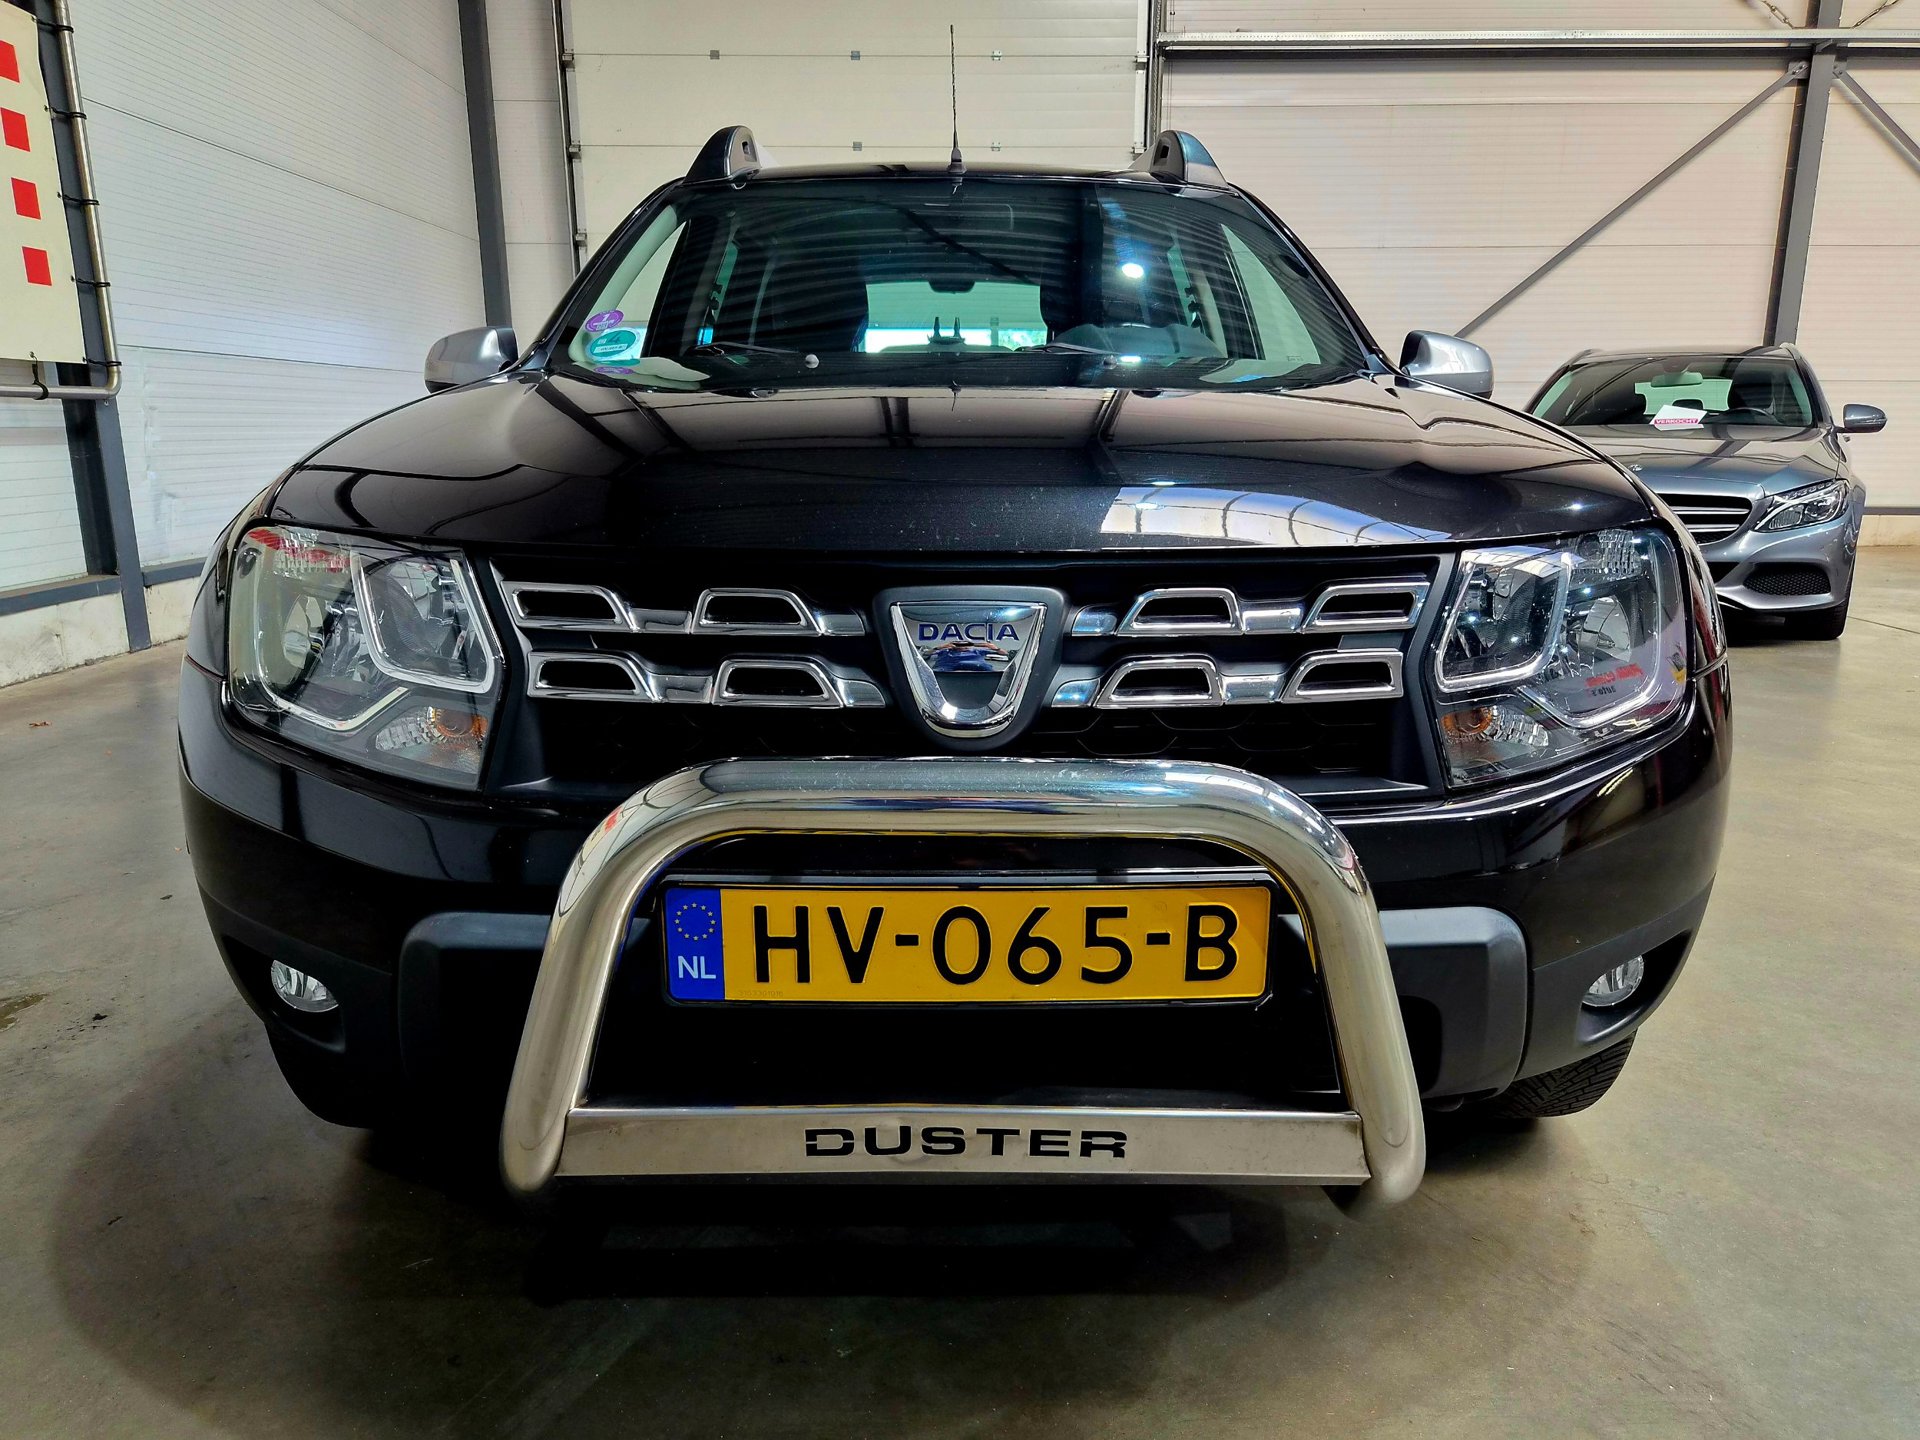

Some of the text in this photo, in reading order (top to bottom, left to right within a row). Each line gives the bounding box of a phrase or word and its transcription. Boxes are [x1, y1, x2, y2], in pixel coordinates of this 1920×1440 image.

[918, 623, 1020, 641] DACIA
[753, 904, 1239, 985] HV-065-B
[677, 955, 717, 980] NL
[804, 1125, 1129, 1159] DUSTER
